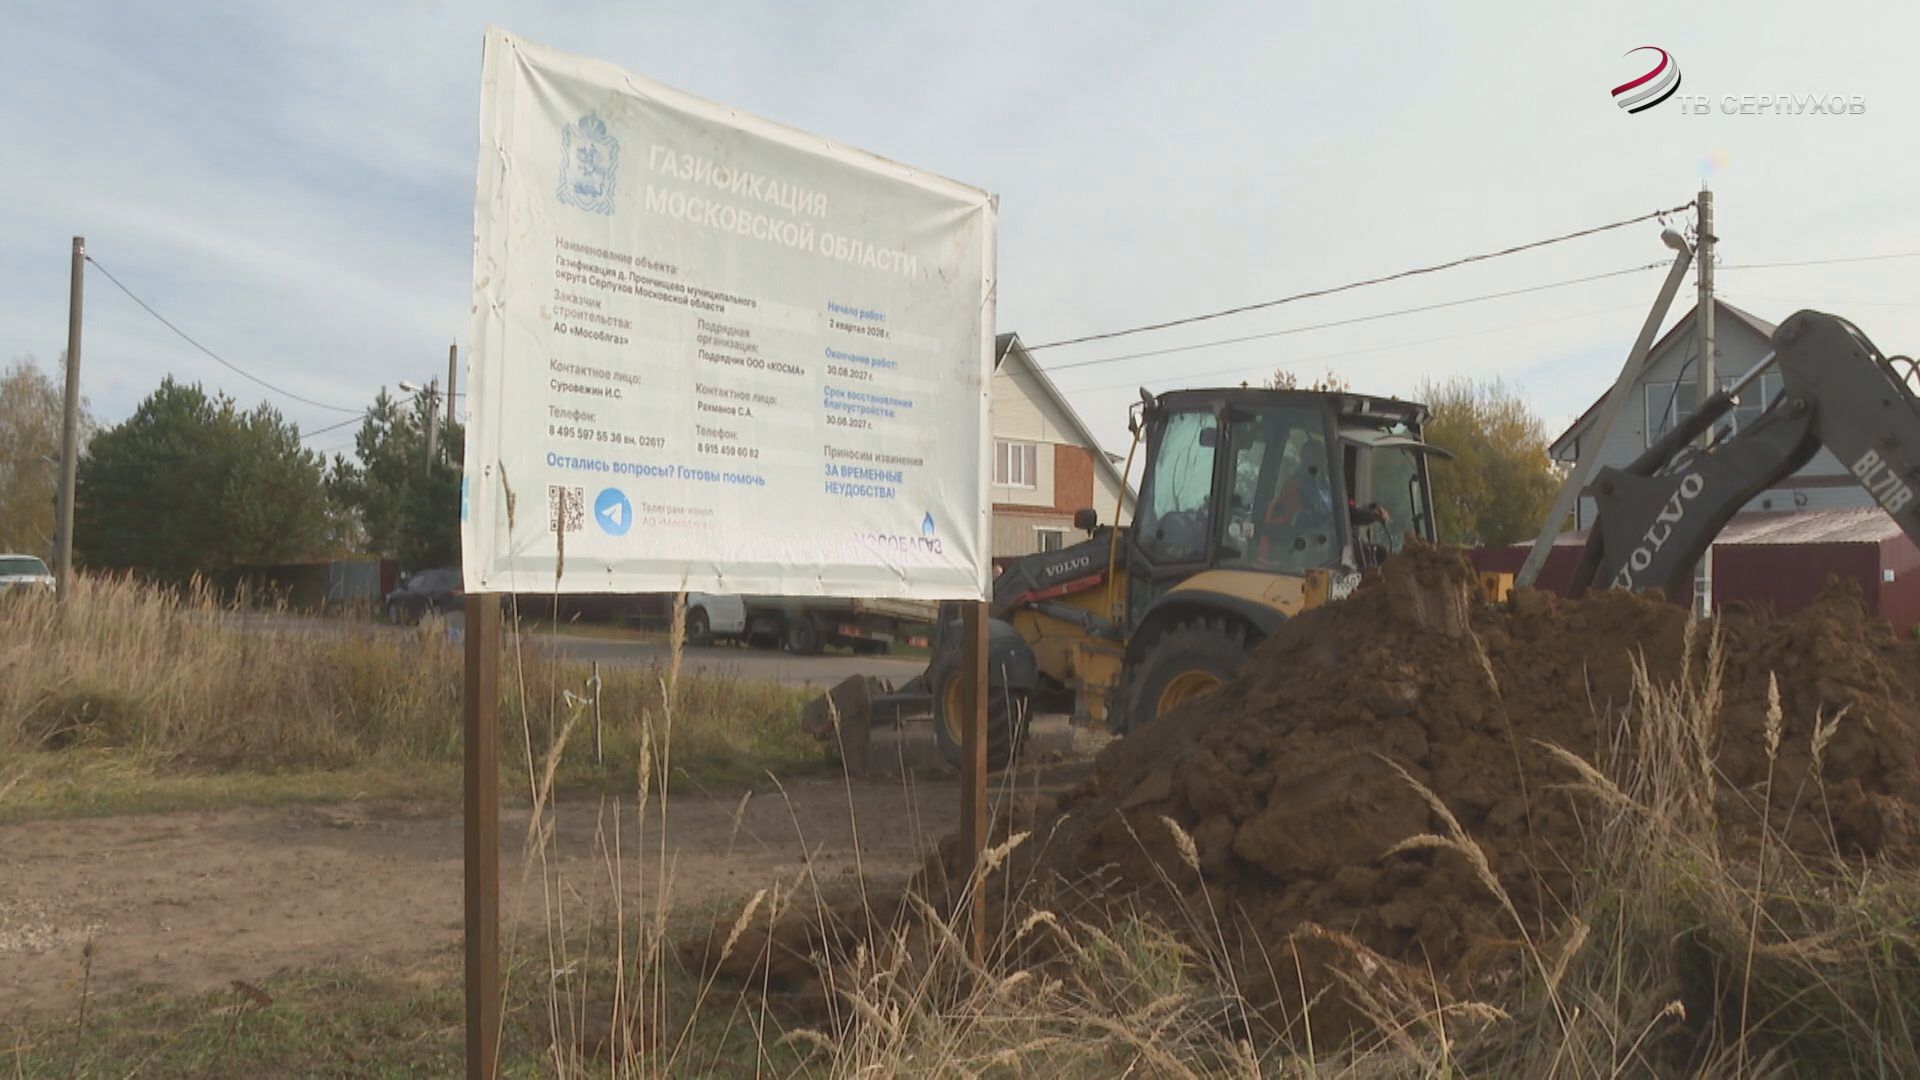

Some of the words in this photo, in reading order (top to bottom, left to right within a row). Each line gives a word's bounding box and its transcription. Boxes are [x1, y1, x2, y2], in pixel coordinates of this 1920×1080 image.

[648, 145, 828, 219] ГАЗИФИКАЦИЯ
[645, 185, 815, 252] МОСКОВСКОЙ
[819, 232, 918, 278] ОБЛАСТИ
[555, 236, 633, 266] Наименование
[635, 257, 679, 275] объекта:
[555, 255, 616, 278] Газификация
[617, 270, 627, 281] д.
[687, 285, 757, 308] муниципального
[555, 270, 587, 286] округа
[589, 276, 633, 295] Серпухов
[634, 286, 689, 306] Московской
[690, 297, 725, 313] области
[553, 306, 633, 330] строительства:
[827, 301, 859, 316] Начало
[553, 322, 567, 335] АО
[569, 327, 629, 345] «Мособлгаз»
[698, 318, 750, 338] Подрядная
[835, 321, 866, 335] квартал
[550, 358, 611, 380] Контактное
[613, 371, 642, 386] лицо:
[698, 349, 745, 366] Подрядчик
[746, 357, 765, 369] ООО
[767, 361, 805, 376] «КОСМА»
[604, 387, 623, 400] И.С.
[696, 383, 750, 401] Контактное
[823, 385, 845, 398] Срок
[548, 405, 596, 423] Телефон:
[549, 424, 555, 436] 8
[557, 425, 575, 438] 495
[824, 445, 873, 462] Приносим
[875, 453, 924, 467] извинения
[546, 452, 610, 472] Остались
[613, 461, 675, 478] вопросы?
[677, 465, 720, 483] Готовы
[723, 472, 765, 486] помочь
[824, 463, 839, 476] ЗА
[841, 465, 903, 484] ВРЕМЕННЫЕ
[824, 481, 896, 499] НЕУДОБСТВА!
[1611, 473, 1704, 591] VOLVO
[1045, 556, 1090, 577] VOLVO
